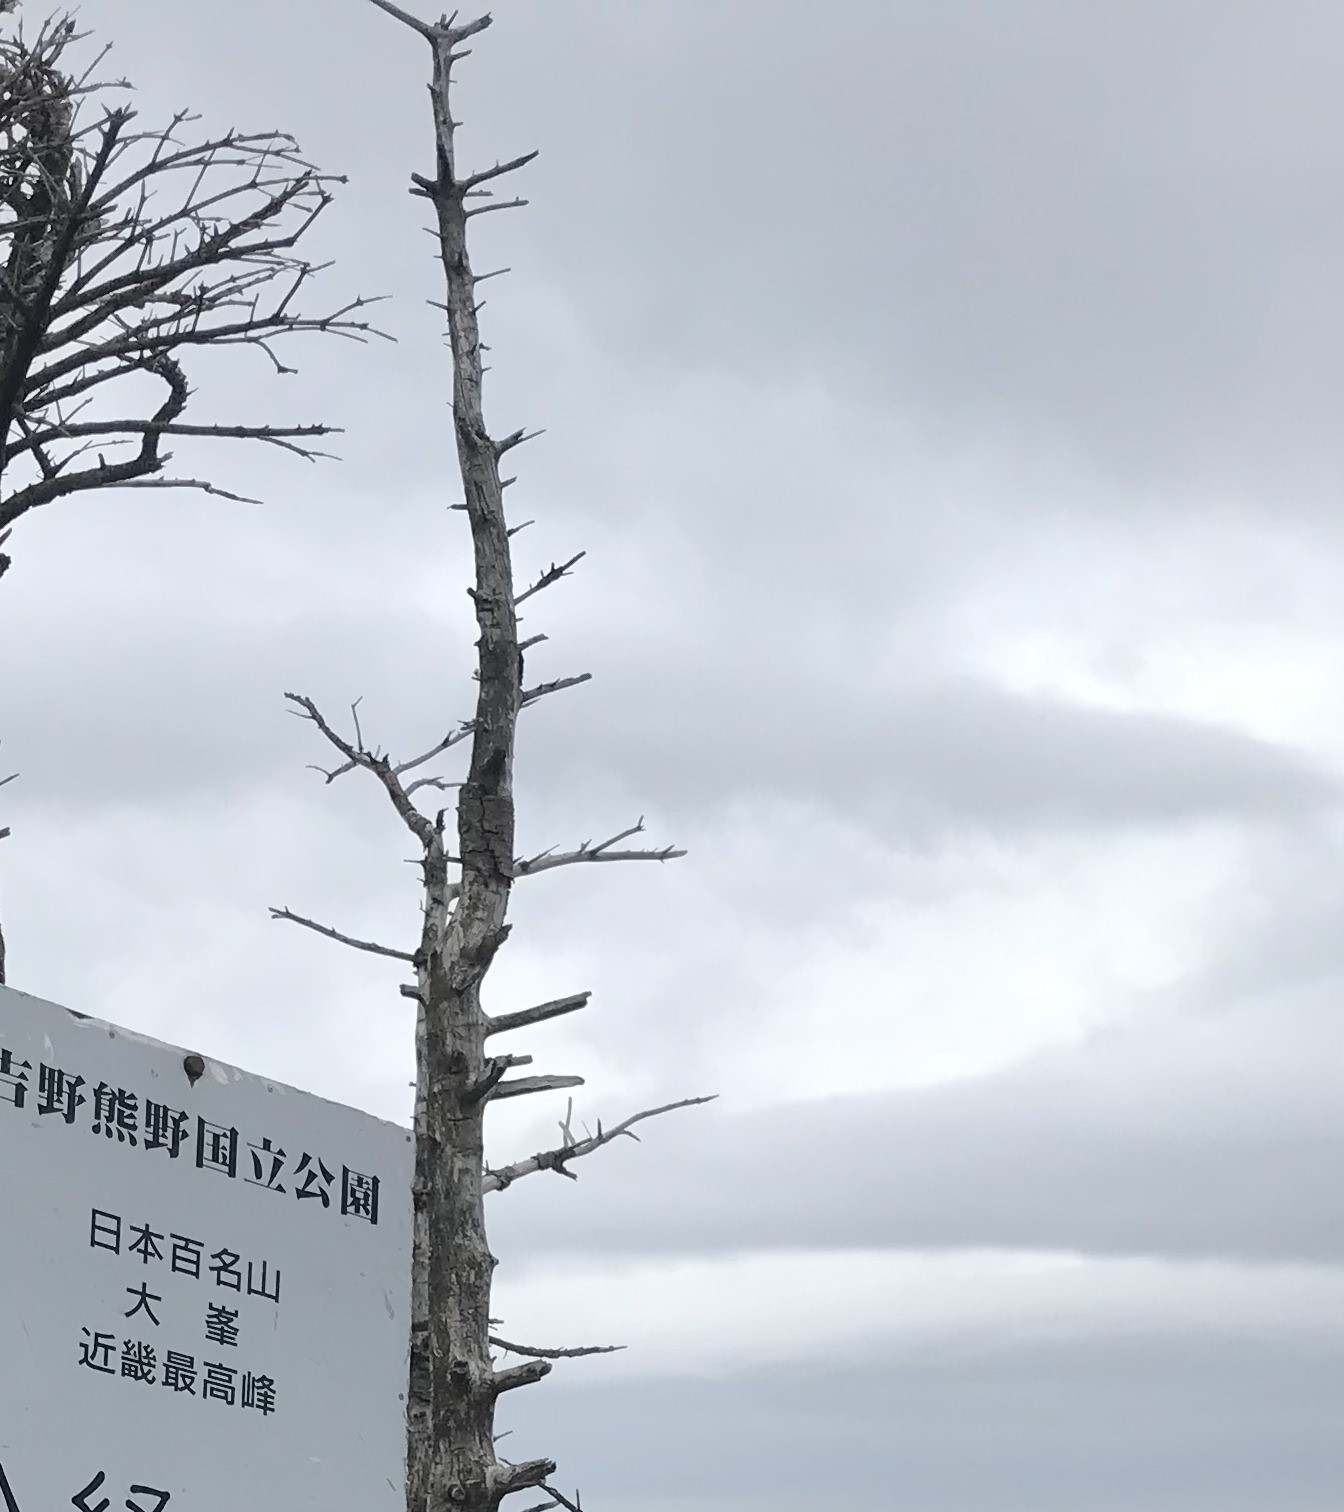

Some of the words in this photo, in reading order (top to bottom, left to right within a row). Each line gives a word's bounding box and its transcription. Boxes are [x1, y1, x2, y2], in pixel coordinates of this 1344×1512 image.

[89, 1208, 281, 1304] 日本百名山
[78, 1327, 278, 1416] 近畿最高峰
